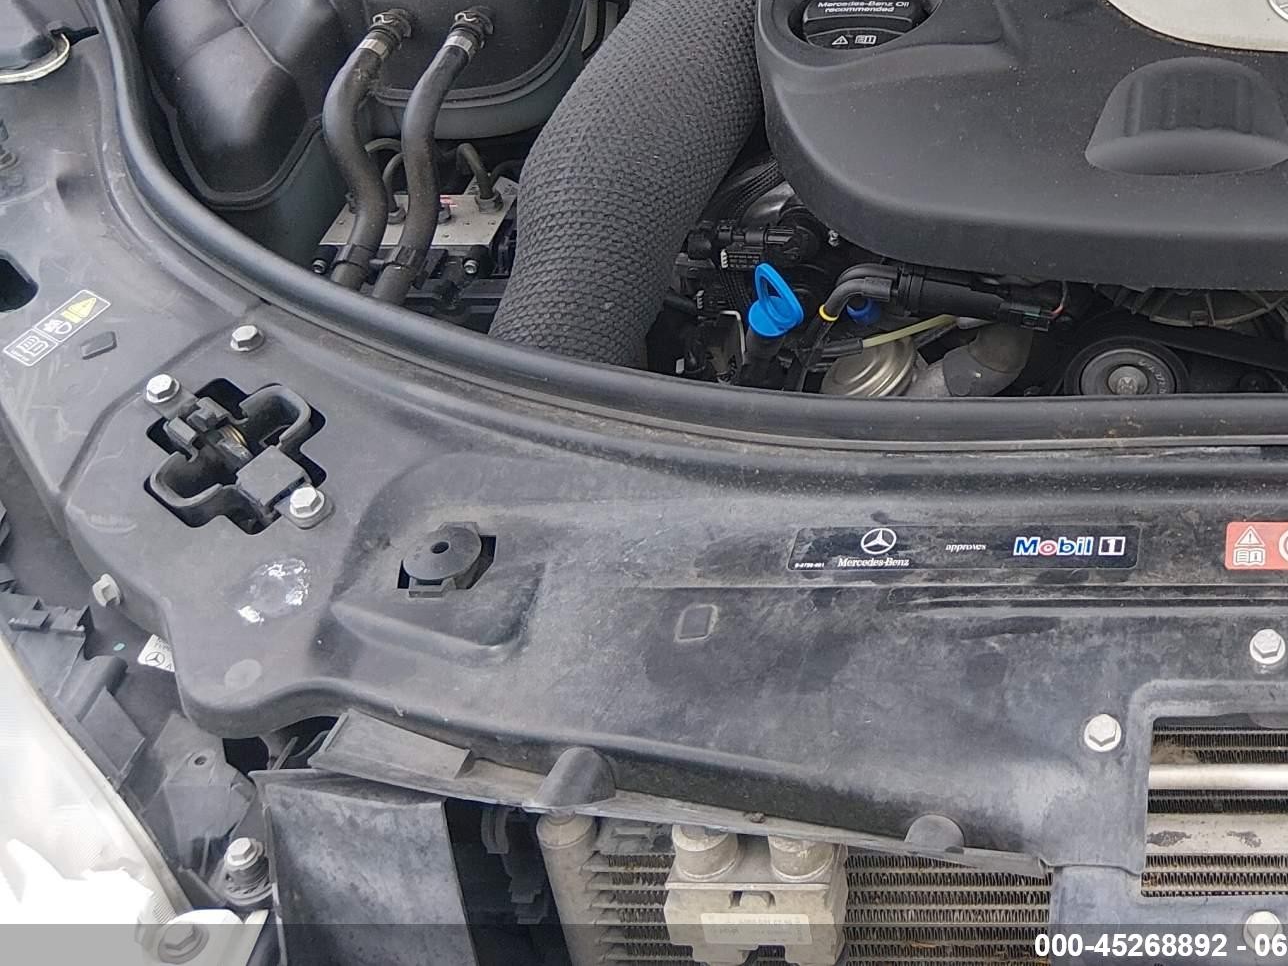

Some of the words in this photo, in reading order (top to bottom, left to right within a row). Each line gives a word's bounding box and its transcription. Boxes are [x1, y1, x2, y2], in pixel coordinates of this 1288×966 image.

[945, 543, 987, 553] approves
[1013, 536, 1094, 556] Mobil
[1102, 537, 1121, 554] 1
[837, 557, 910, 568] Mercedes-Benz
